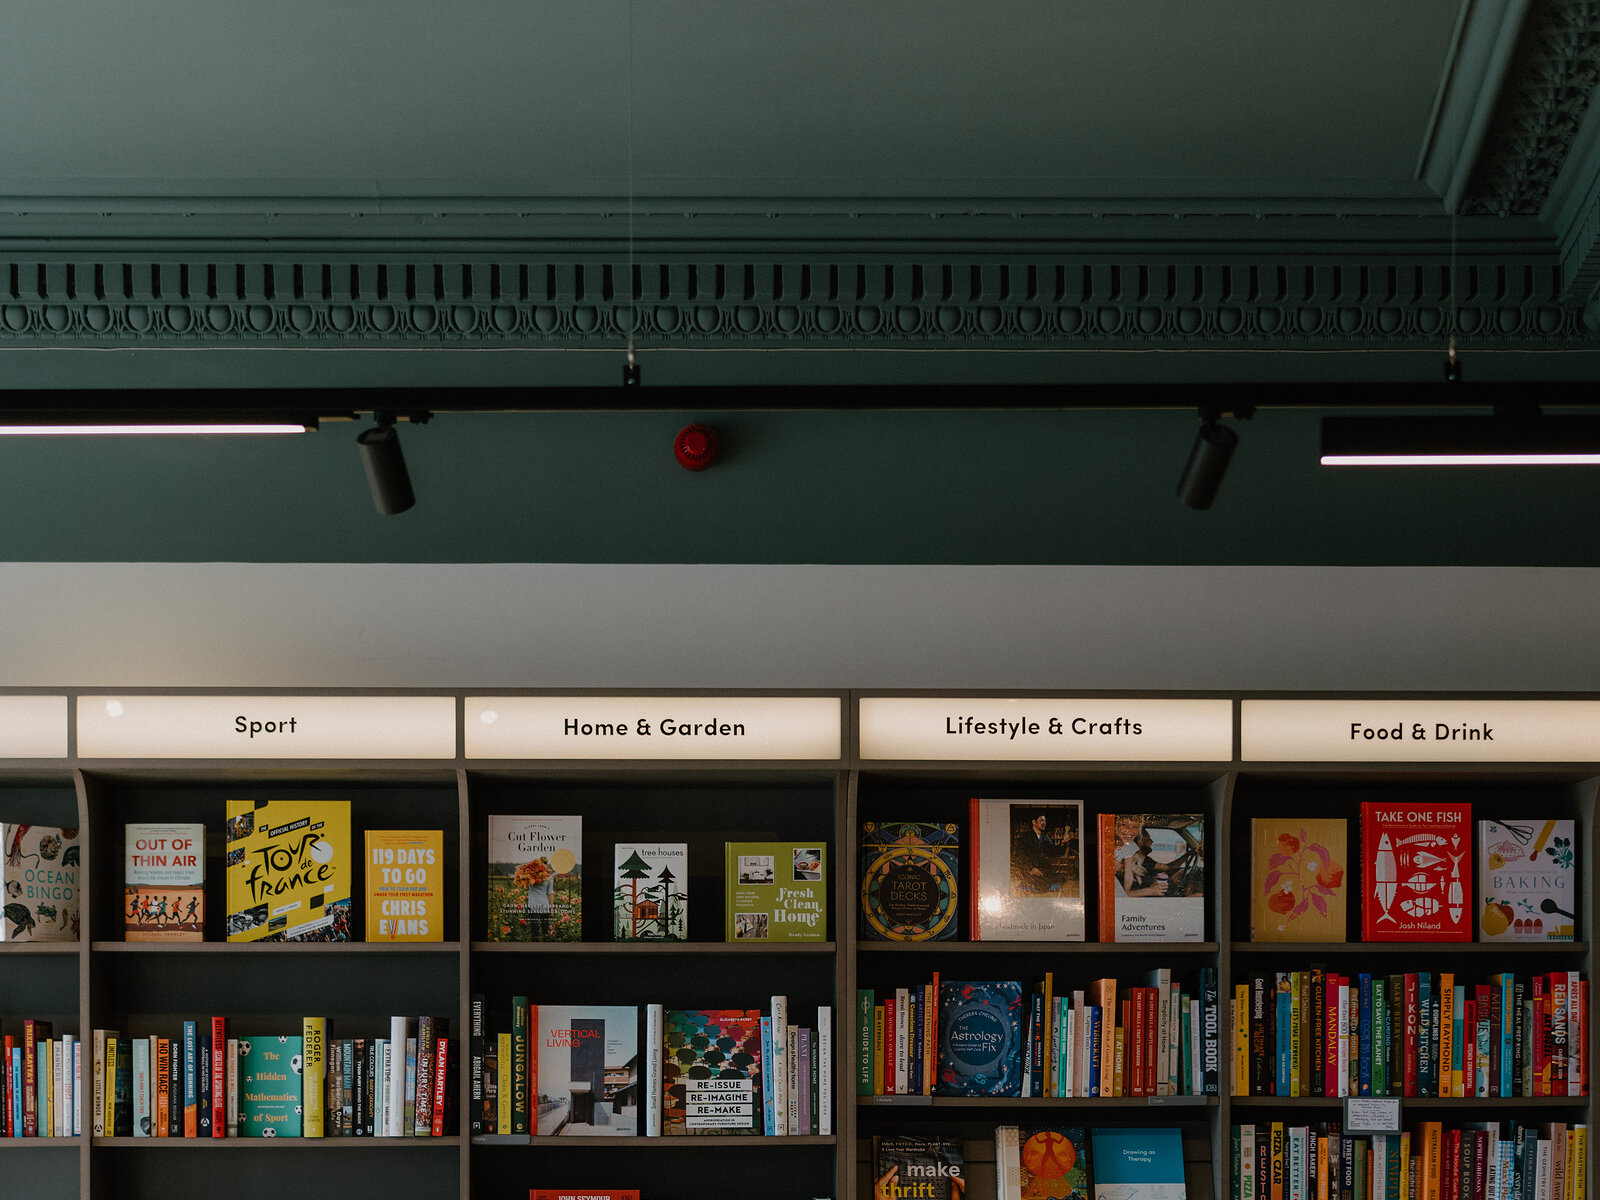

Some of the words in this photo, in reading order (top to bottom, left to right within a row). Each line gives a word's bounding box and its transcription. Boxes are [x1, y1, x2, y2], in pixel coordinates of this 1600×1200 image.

[235, 715, 297, 738] Sport
[564, 718, 628, 736] Home
[637, 718, 651, 736] &
[660, 718, 745, 736] Garden
[947, 716, 1040, 740] Lifestyle
[1048, 717, 1063, 735] &
[1072, 716, 1143, 735] Crafts
[1351, 723, 1403, 740] Food
[1412, 723, 1426, 740] &
[1435, 722, 1494, 740] Drink
[1375, 811, 1403, 822] TAKE
[1407, 811, 1433, 822] ONE
[1437, 812, 1461, 823] FISH
[270, 823, 289, 837] OFFICIAL
[289, 819, 308, 830] HISTORY
[508, 832, 526, 842] Cut
[530, 832, 566, 842] Flower
[135, 839, 167, 850] OUT
[172, 839, 192, 850] OF
[518, 843, 556, 852] Garden
[373, 848, 394, 864] 119
[397, 848, 435, 864] DAYS
[658, 848, 683, 856] houses
[132, 855, 167, 867] THIN
[172, 855, 197, 867] AIR
[300, 858, 313, 869] de
[25, 869, 75, 884] OCEAN
[381, 868, 401, 884] TO
[405, 868, 427, 884] GO
[1494, 876, 1565, 888] BAKING
[893, 881, 927, 891] TAROT
[27, 887, 73, 900] BINGO
[776, 888, 814, 902] Fresh
[890, 891, 927, 901] DECKS
[381, 900, 426, 916] CHRIS
[784, 899, 822, 912] Clean
[774, 909, 820, 927] Home
[1121, 915, 1146, 923] Family
[379, 920, 428, 936] EVANS
[1038, 923, 1055, 932] Japan
[1398, 922, 1416, 930] Josh
[1417, 922, 1441, 930] Niland
[1376, 997, 1382, 1007] TO
[1554, 984, 1566, 1006] RED
[1443, 988, 1451, 1021] SIMPLY
[1420, 999, 1429, 1026] WILD
[1554, 1008, 1566, 1044] SANDS
[550, 1029, 600, 1039] VERTICAL
[951, 1031, 1003, 1043] Astrology
[1328, 1006, 1336, 1065] MANDALAY
[305, 1025, 313, 1068] FEDERER
[547, 1039, 581, 1048] LIVING
[982, 1042, 996, 1052] Fix
[1442, 1023, 1450, 1072] RAYMOND
[263, 1051, 279, 1060] The
[438, 1041, 446, 1068] DYLAN
[1419, 1029, 1429, 1073] KITCHEN
[256, 1072, 287, 1081] Hidden
[516, 1035, 524, 1113] JUNGALOW
[436, 1069, 444, 1105] HARTLEY
[697, 1081, 741, 1089] RE-ISSUE
[245, 1093, 297, 1102] Mathematics
[691, 1094, 747, 1102] RE-IMAGINE
[697, 1106, 741, 1114] RE-MAKE
[1273, 1130, 1281, 1156] PIZZA
[907, 1161, 960, 1177] make
[1273, 1160, 1281, 1184] CZAR
[881, 1182, 935, 1198] thrift
